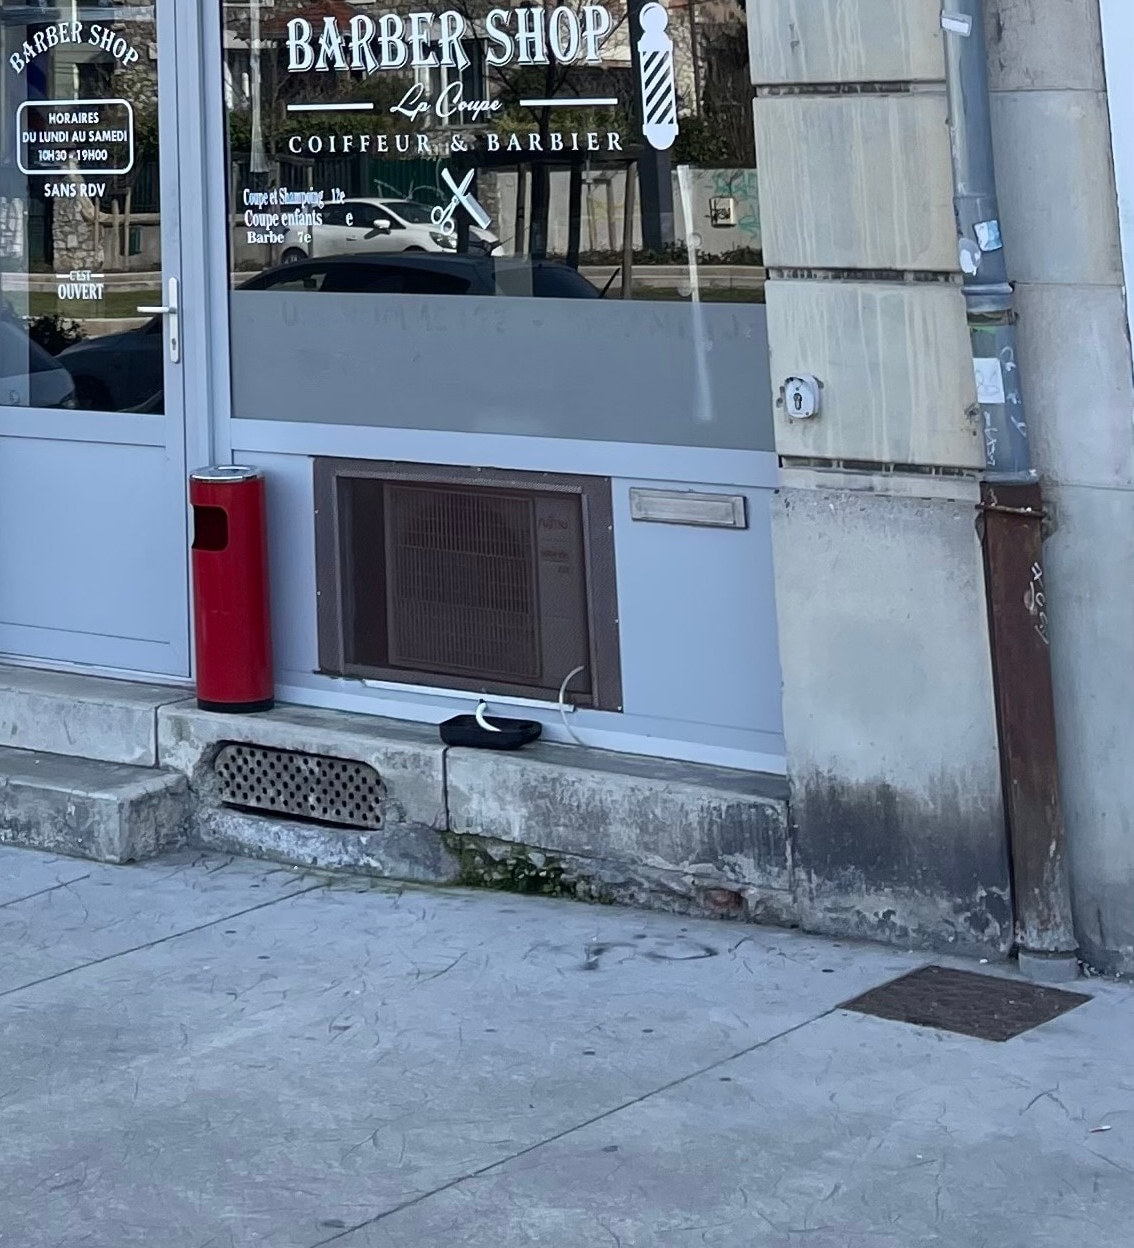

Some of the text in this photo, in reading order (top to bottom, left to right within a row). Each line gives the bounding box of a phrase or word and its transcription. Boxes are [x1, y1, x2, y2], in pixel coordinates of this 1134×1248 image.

[9, 20, 139, 74] BARBER SHOP
[286, 4, 614, 75] BARBER SHOP
[435, 81, 503, 121] Coupe
[48, 112, 100, 124] HORAIRES
[22, 129, 128, 143] DU LUNDI AU SAMEDI
[288, 131, 623, 153] COIFFEUR & BARBIER
[76, 149, 108, 161] 19H00
[44, 183, 106, 198] SANS RDV
[243, 188, 269, 209] Coupe
[244, 209, 279, 231] Coupe
[281, 208, 323, 226] enfants
[246, 231, 285, 244] Barbe
[57, 283, 105, 300] OUVERT
